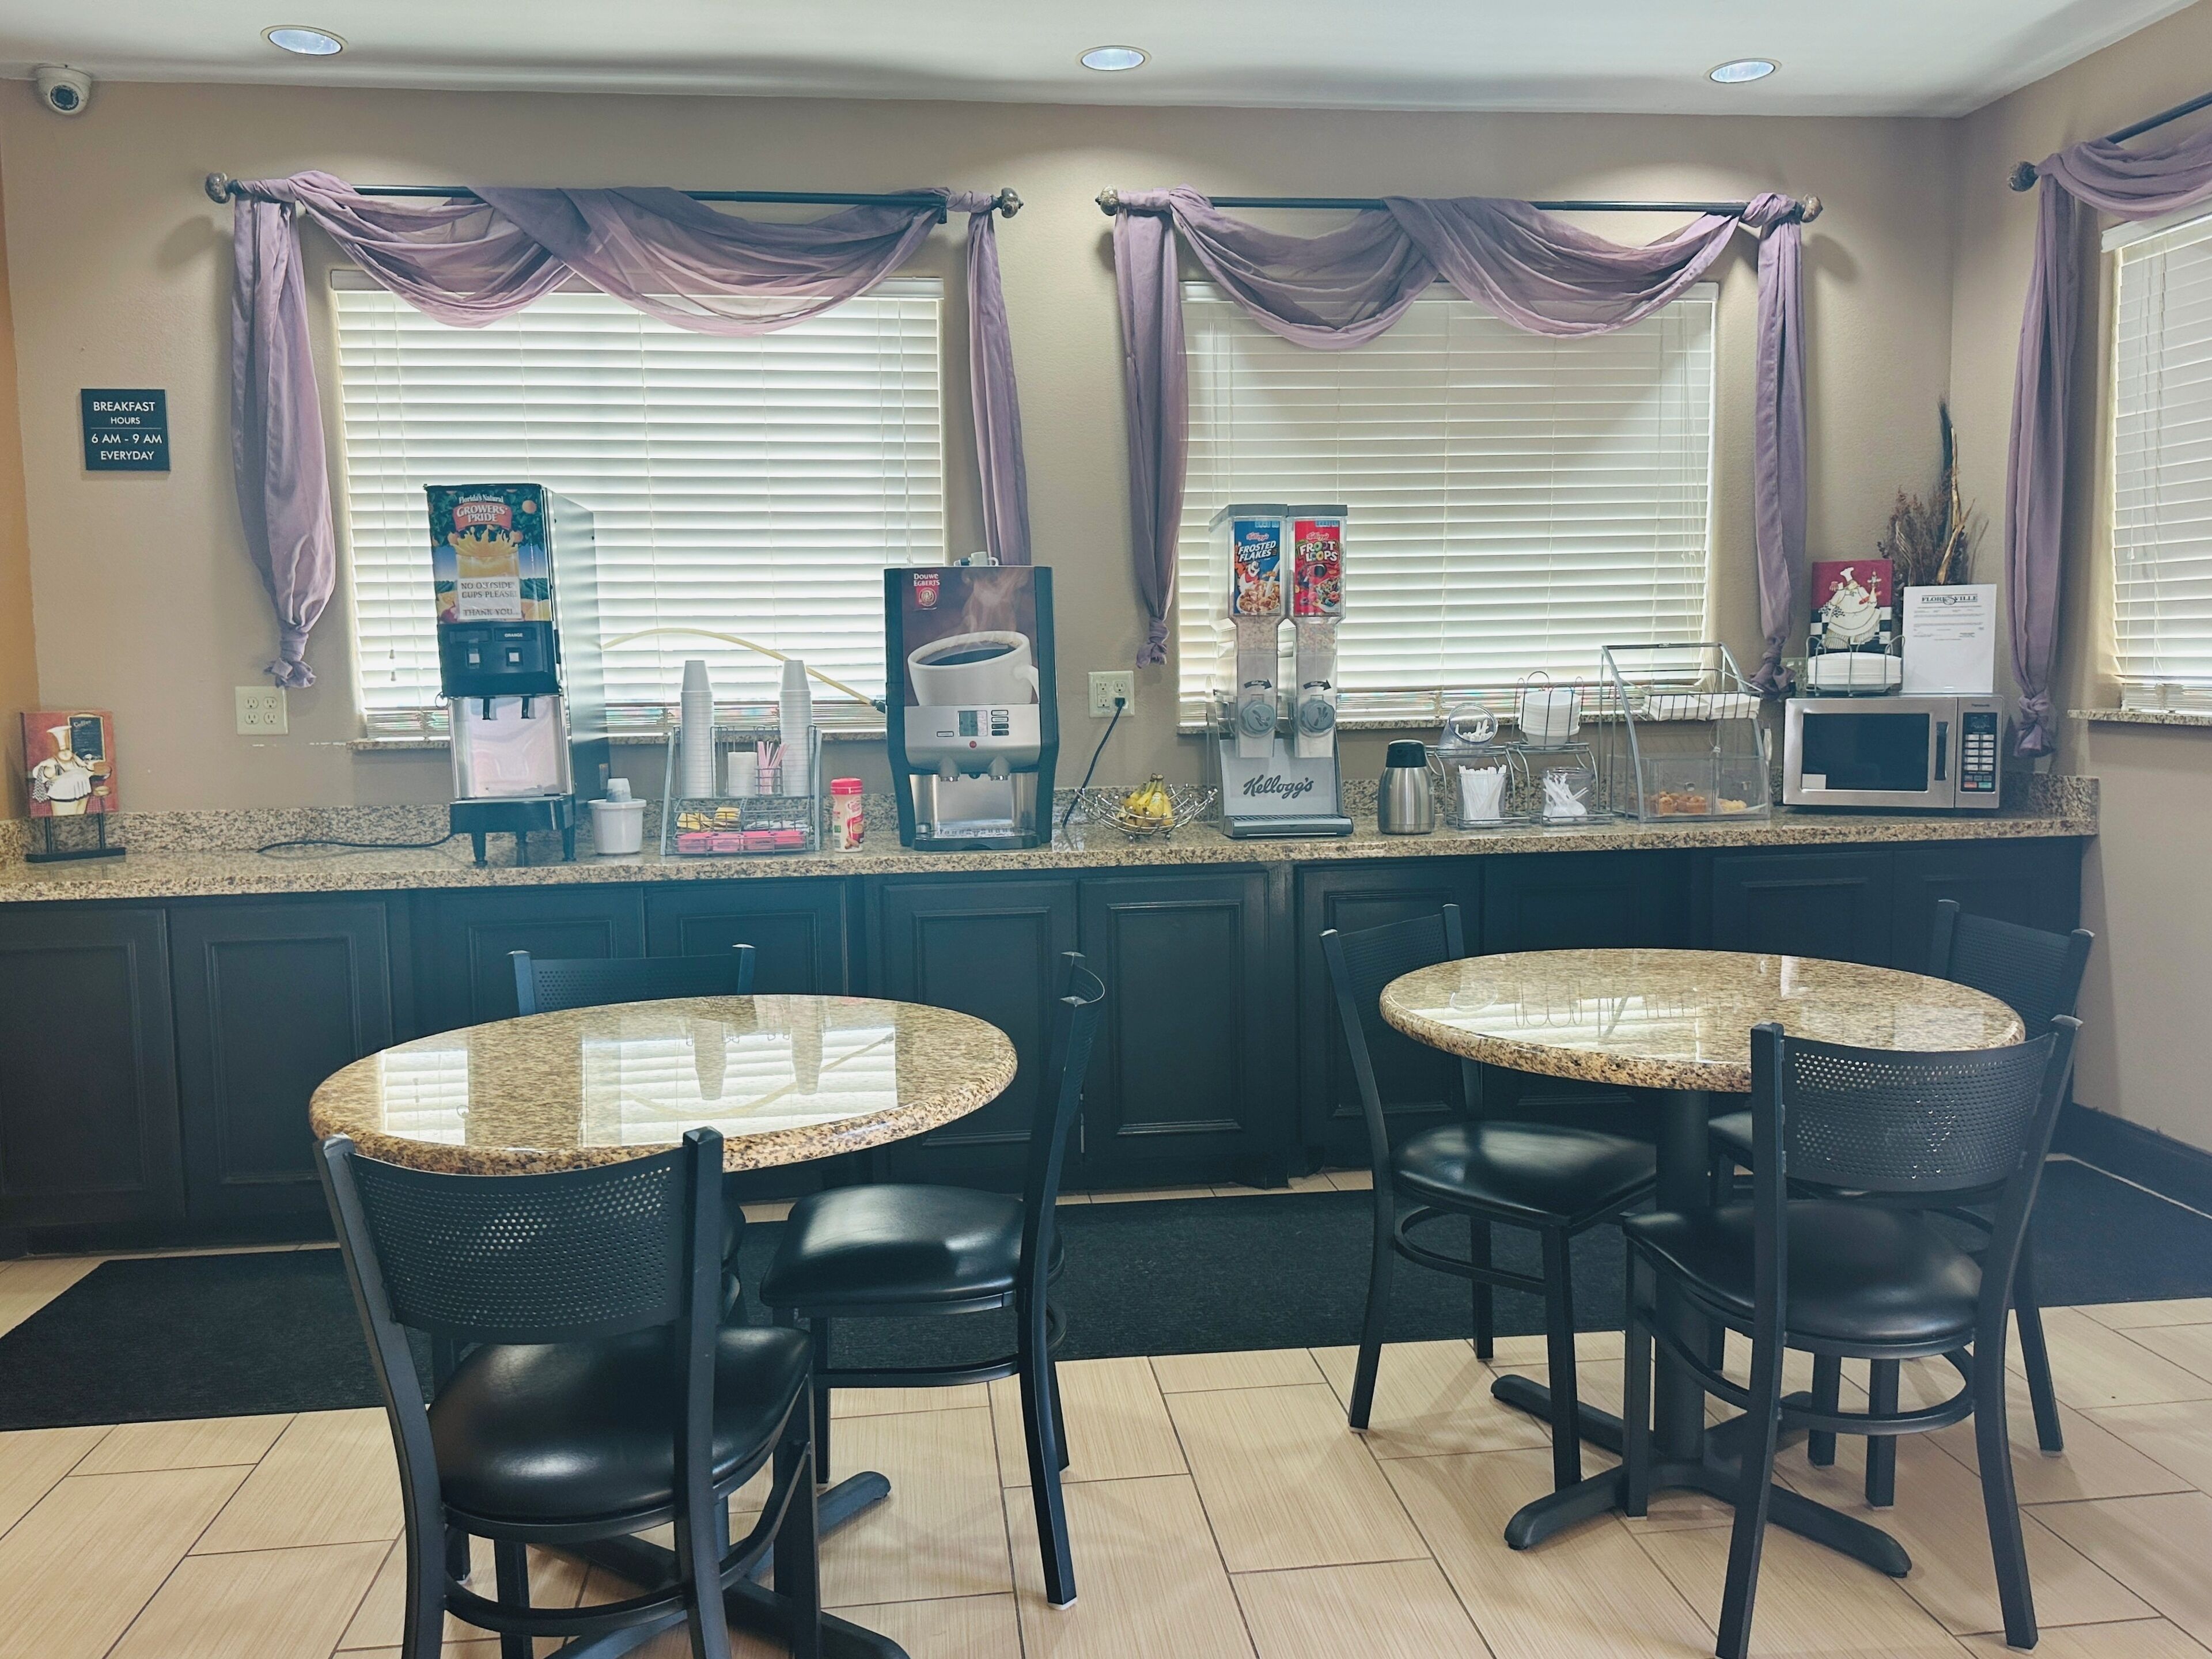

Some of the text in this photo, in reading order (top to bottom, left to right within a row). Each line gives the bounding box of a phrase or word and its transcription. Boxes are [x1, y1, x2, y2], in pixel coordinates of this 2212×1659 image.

[93, 402, 155, 411] BREAKFAST
[91, 433, 99, 444] 6
[102, 434, 121, 443] AM
[132, 434, 139, 444] 9
[143, 434, 162, 444] AM
[101, 451, 154, 460] EVERYDAY
[482, 494, 504, 502] Natural
[468, 513, 498, 522] PRIDE
[1238, 540, 1277, 555] FROSTED
[1300, 541, 1335, 555] FROOT
[1239, 549, 1272, 562] FLAKES
[1305, 551, 1338, 562] LOOPS
[1243, 774, 1314, 799] Kellogg's
